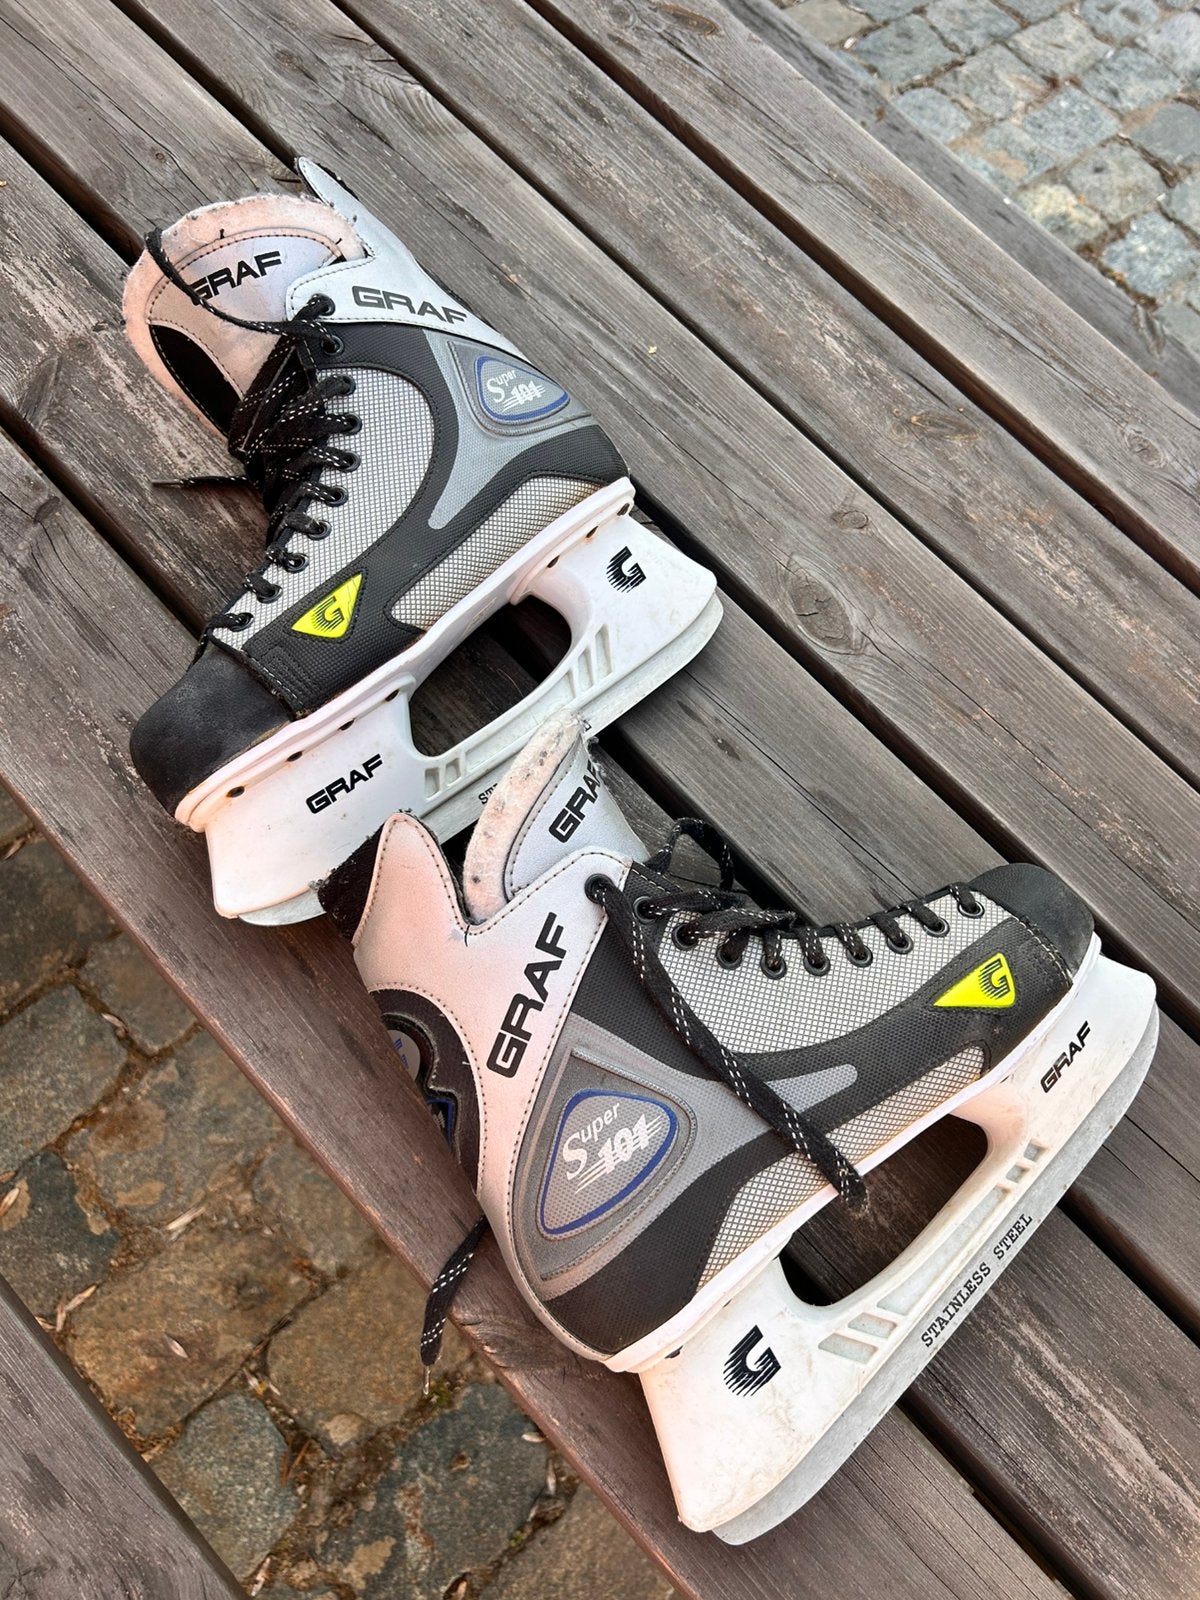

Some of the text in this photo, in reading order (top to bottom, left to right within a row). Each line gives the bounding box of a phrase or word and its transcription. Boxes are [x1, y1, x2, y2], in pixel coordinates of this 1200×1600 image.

[188, 251, 282, 300] GRAF
[352, 285, 467, 325] GRAF
[486, 369, 517, 403] Super
[606, 546, 647, 593] G
[310, 595, 344, 632] G
[306, 754, 383, 814] GRAF
[486, 911, 567, 1079] GRAF
[978, 958, 1010, 1000] G
[1040, 1020, 1091, 1094] GRAF
[563, 1103, 620, 1180] Super
[921, 1213, 1033, 1348] STAINLESS STEEL
[723, 1325, 782, 1397] G
